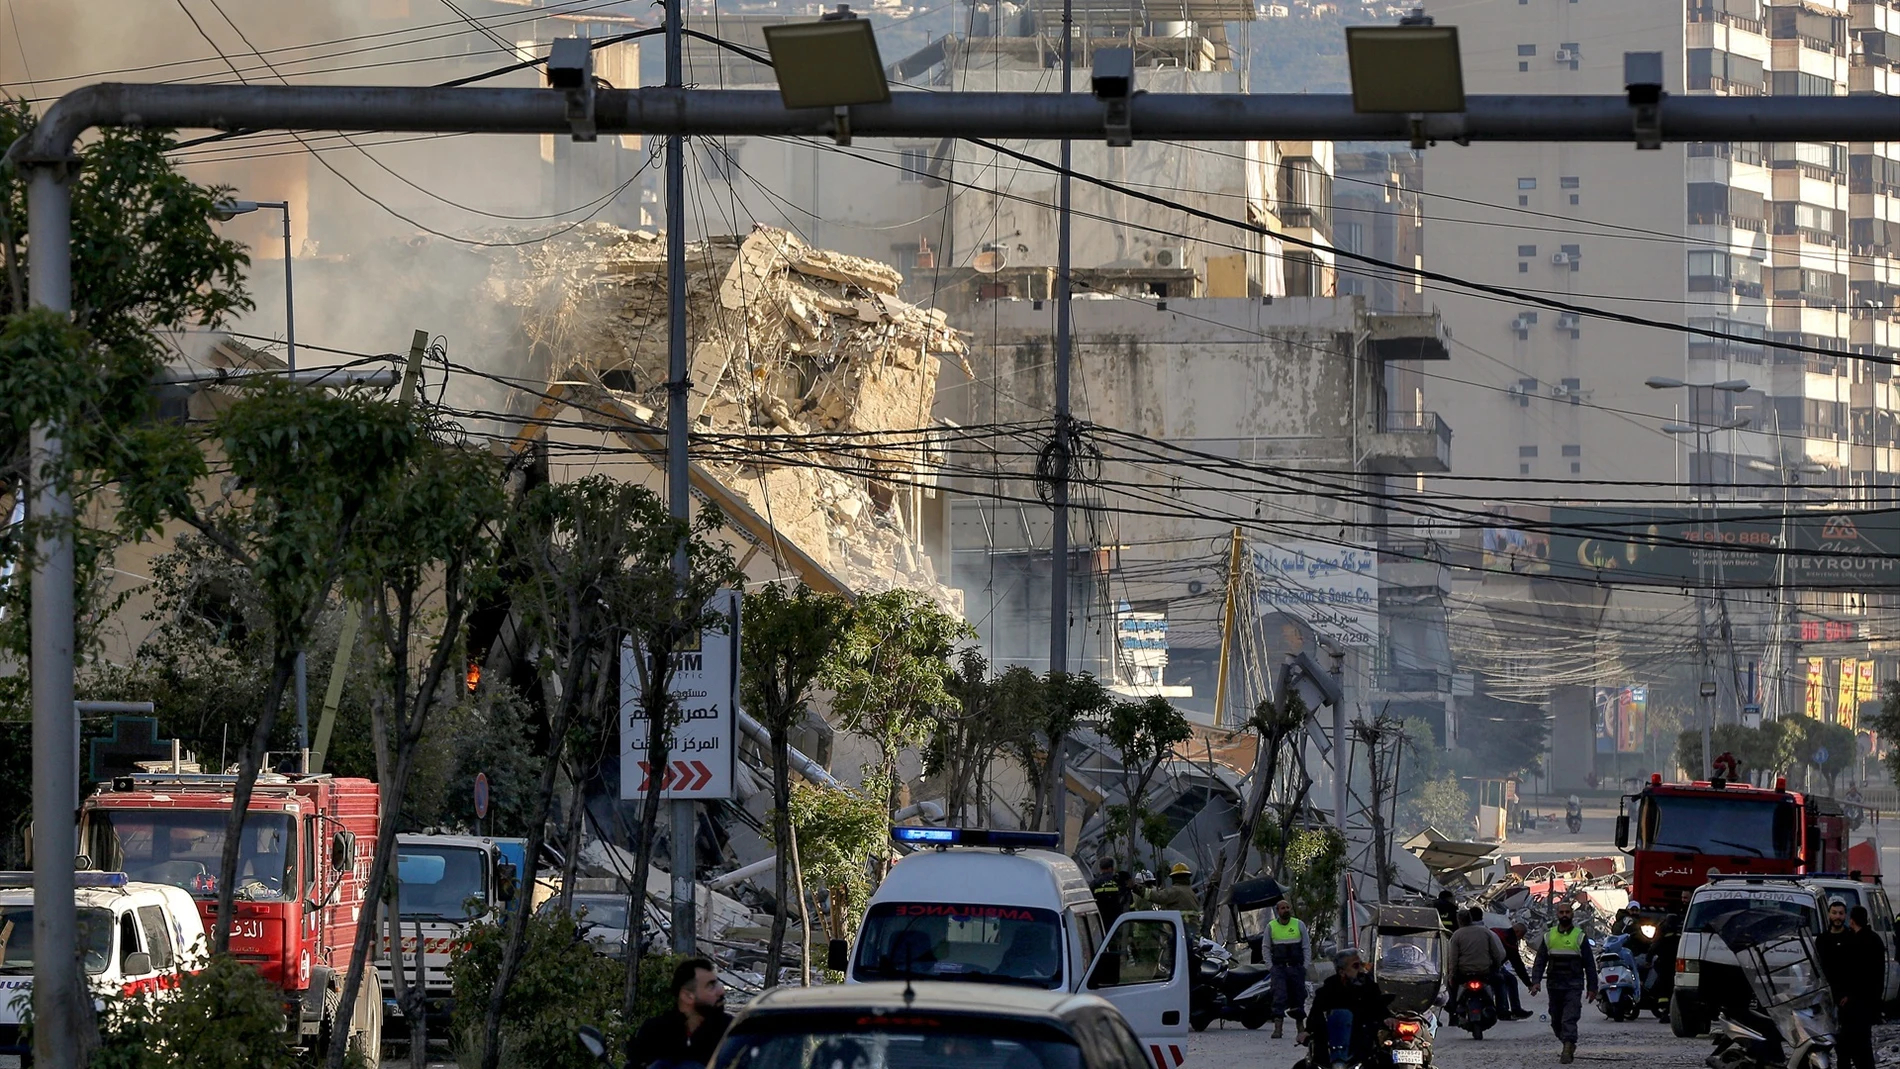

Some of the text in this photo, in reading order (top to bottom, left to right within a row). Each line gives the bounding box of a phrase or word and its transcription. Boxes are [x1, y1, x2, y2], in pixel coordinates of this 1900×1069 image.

[1739, 532, 1770, 544] 888
[1788, 558, 1893, 570] BEYROUTH
[681, 737, 719, 752] المركز
[1655, 867, 1693, 877] المدني
